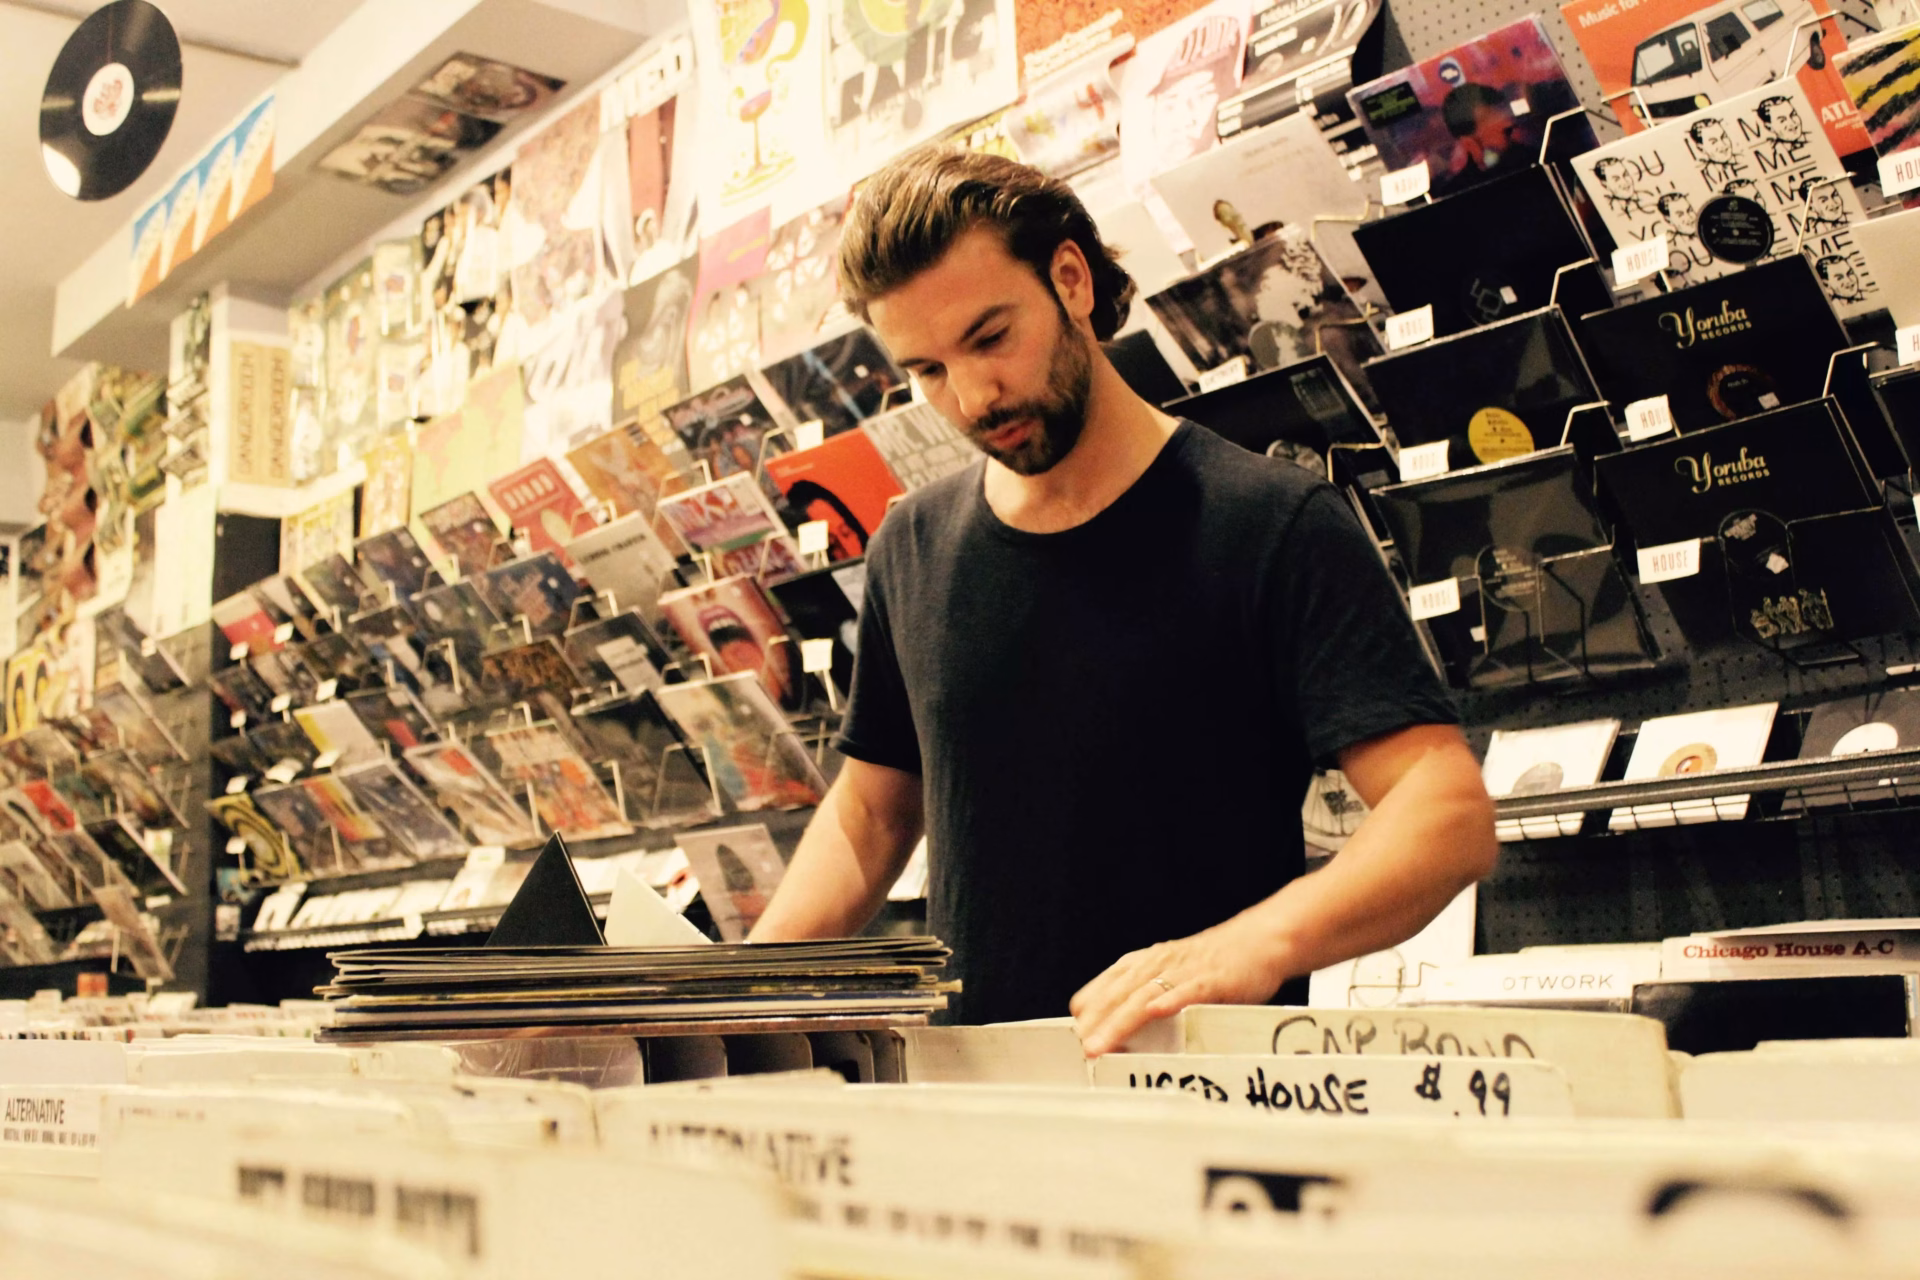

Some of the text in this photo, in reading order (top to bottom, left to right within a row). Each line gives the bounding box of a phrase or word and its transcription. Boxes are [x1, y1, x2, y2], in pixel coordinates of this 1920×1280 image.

[1578, 3, 1619, 28] Music
[1754, 146, 1812, 174] ME
[1658, 299, 1748, 349] Yoruba
[1701, 321, 1752, 341] RECORDS
[1675, 446, 1767, 494] Yoruba
[1717, 469, 1770, 487] RECORDS
[1652, 550, 1688, 574] HOUSE
[1683, 938, 1894, 960] Chicago House A-C
[1245, 1067, 1369, 1116] HOUSE
[5, 1099, 64, 1125] ALTERNATIVE
[649, 1123, 854, 1187] TERNATIVE
